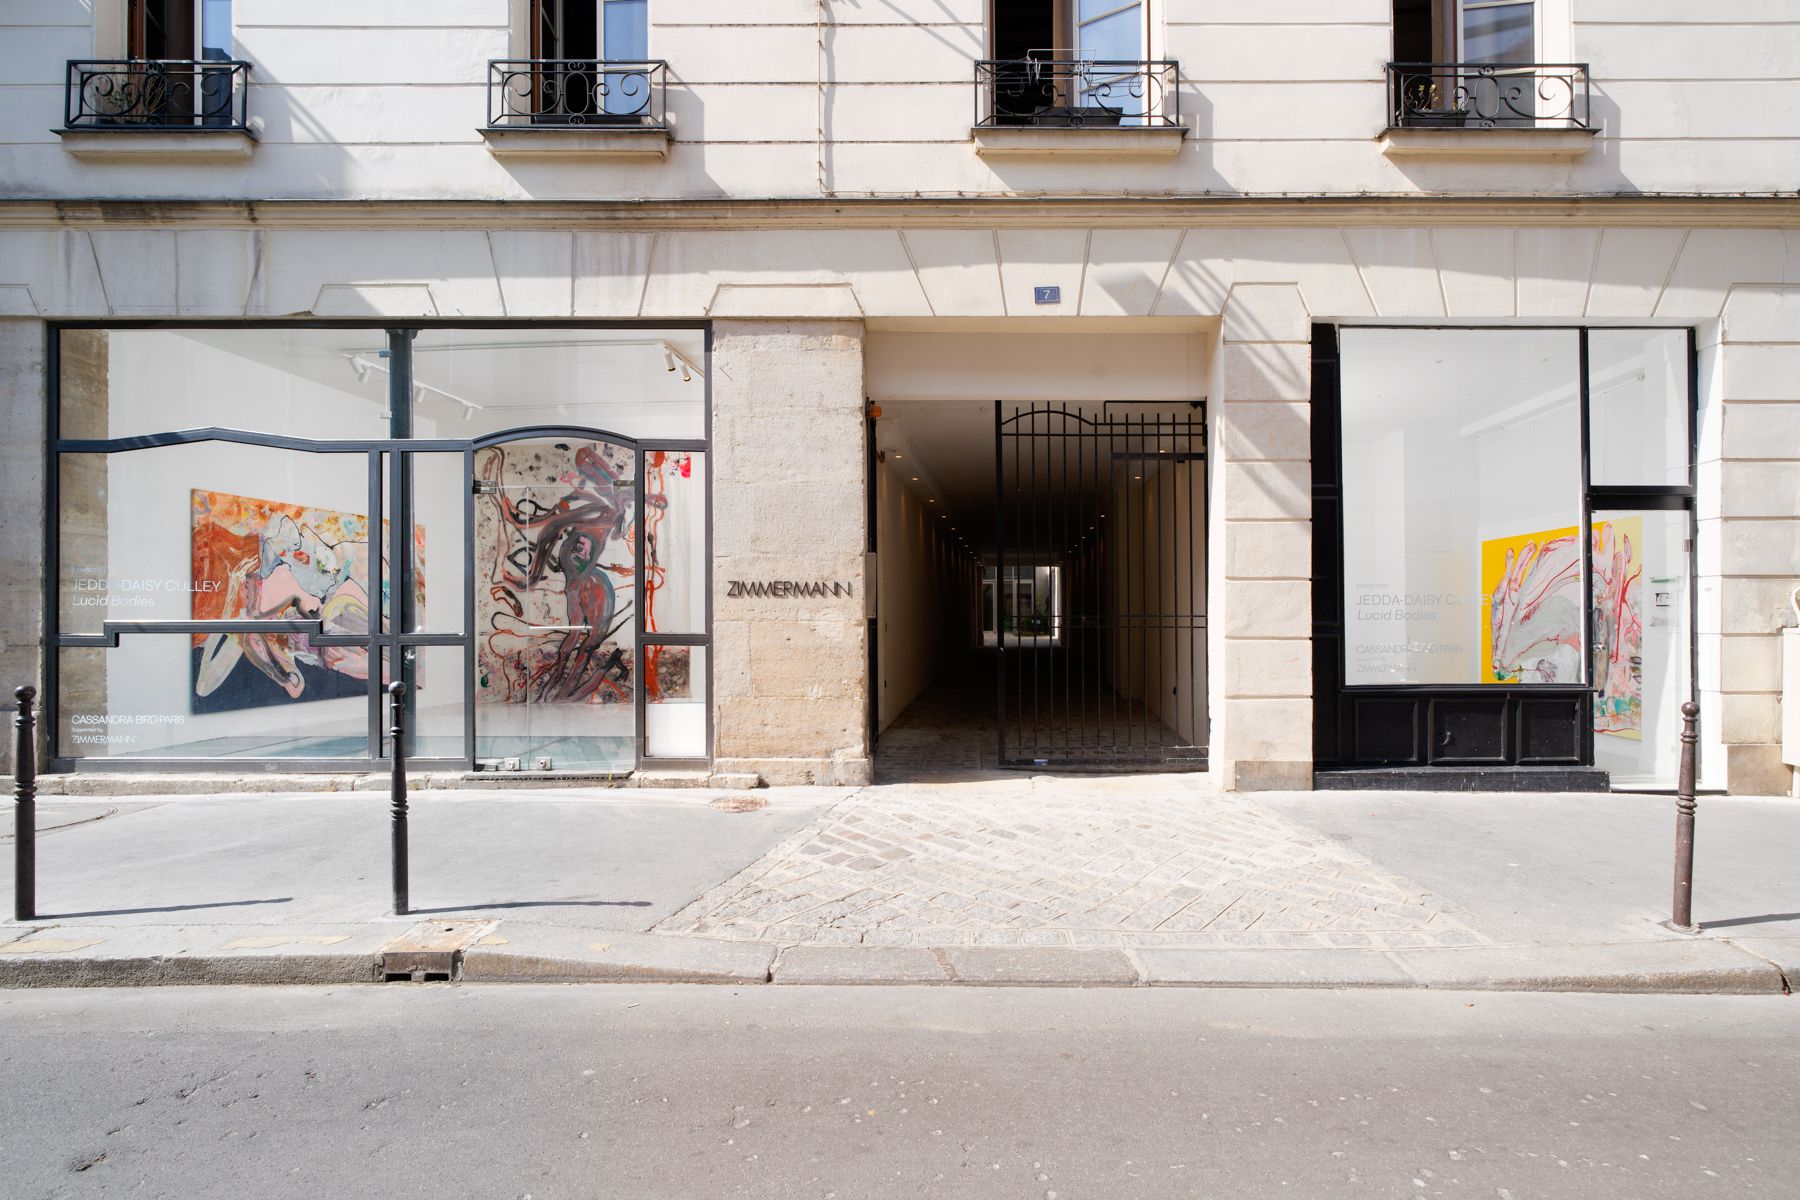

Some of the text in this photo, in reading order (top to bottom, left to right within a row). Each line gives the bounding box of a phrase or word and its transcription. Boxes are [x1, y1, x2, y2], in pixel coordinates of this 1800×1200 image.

[1043, 289, 1051, 300] 7
[72, 579, 221, 592] JEDD-DAISY CULLEY
[727, 580, 852, 597] ZIMMERMANN
[72, 595, 155, 606] Lucid Bodies
[1356, 593, 1498, 606] JEDDA-DAISY CUEY
[1357, 609, 1436, 621] Lucid Bodies
[72, 715, 185, 724] CASSANDRA BIRD PARIS
